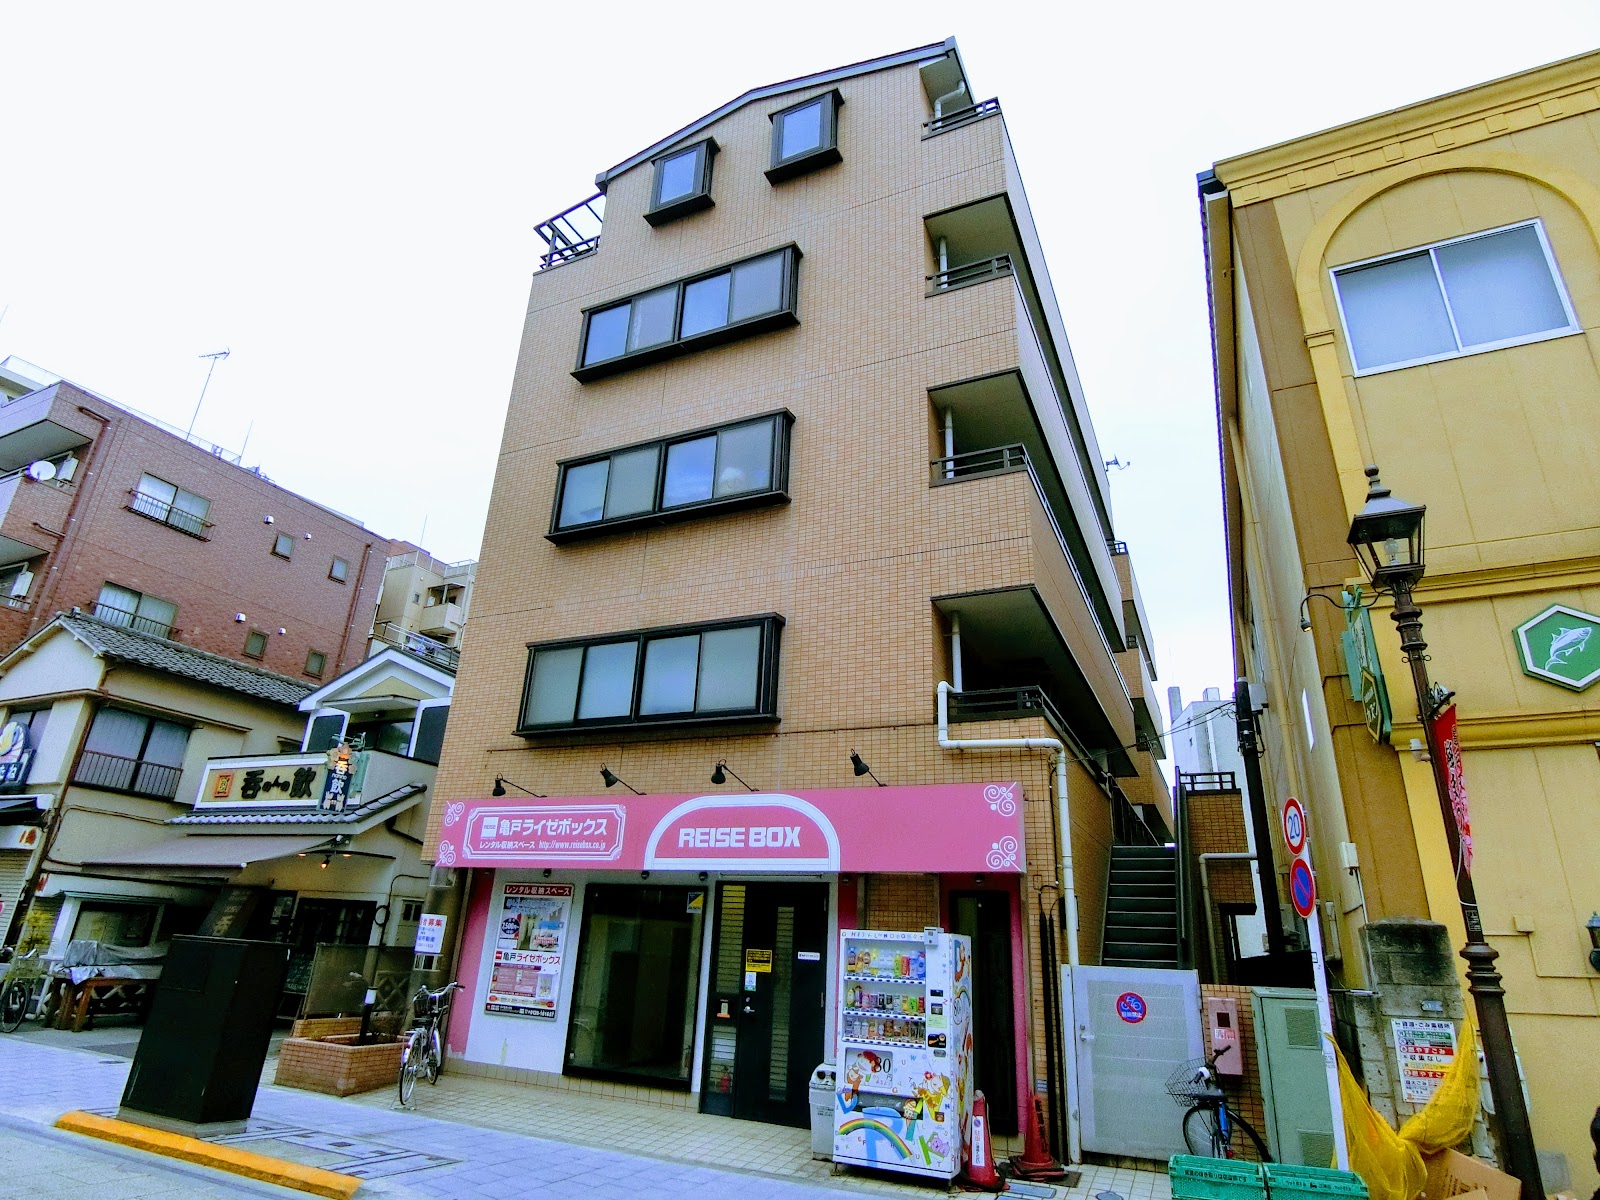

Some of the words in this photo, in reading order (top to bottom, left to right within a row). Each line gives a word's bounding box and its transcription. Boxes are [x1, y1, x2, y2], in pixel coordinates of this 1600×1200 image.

[331, 780, 343, 794] 飲
[499, 818, 608, 836] 亀戸ライゼボックス
[1288, 813, 1300, 840] 20
[678, 827, 746, 848] REISE
[748, 826, 801, 848] BOX
[479, 840, 535, 850] レンタル収納スペース
[506, 886, 570, 896] レンタル収納スペース
[503, 951, 561, 965] 亀戸ライゼボックス
